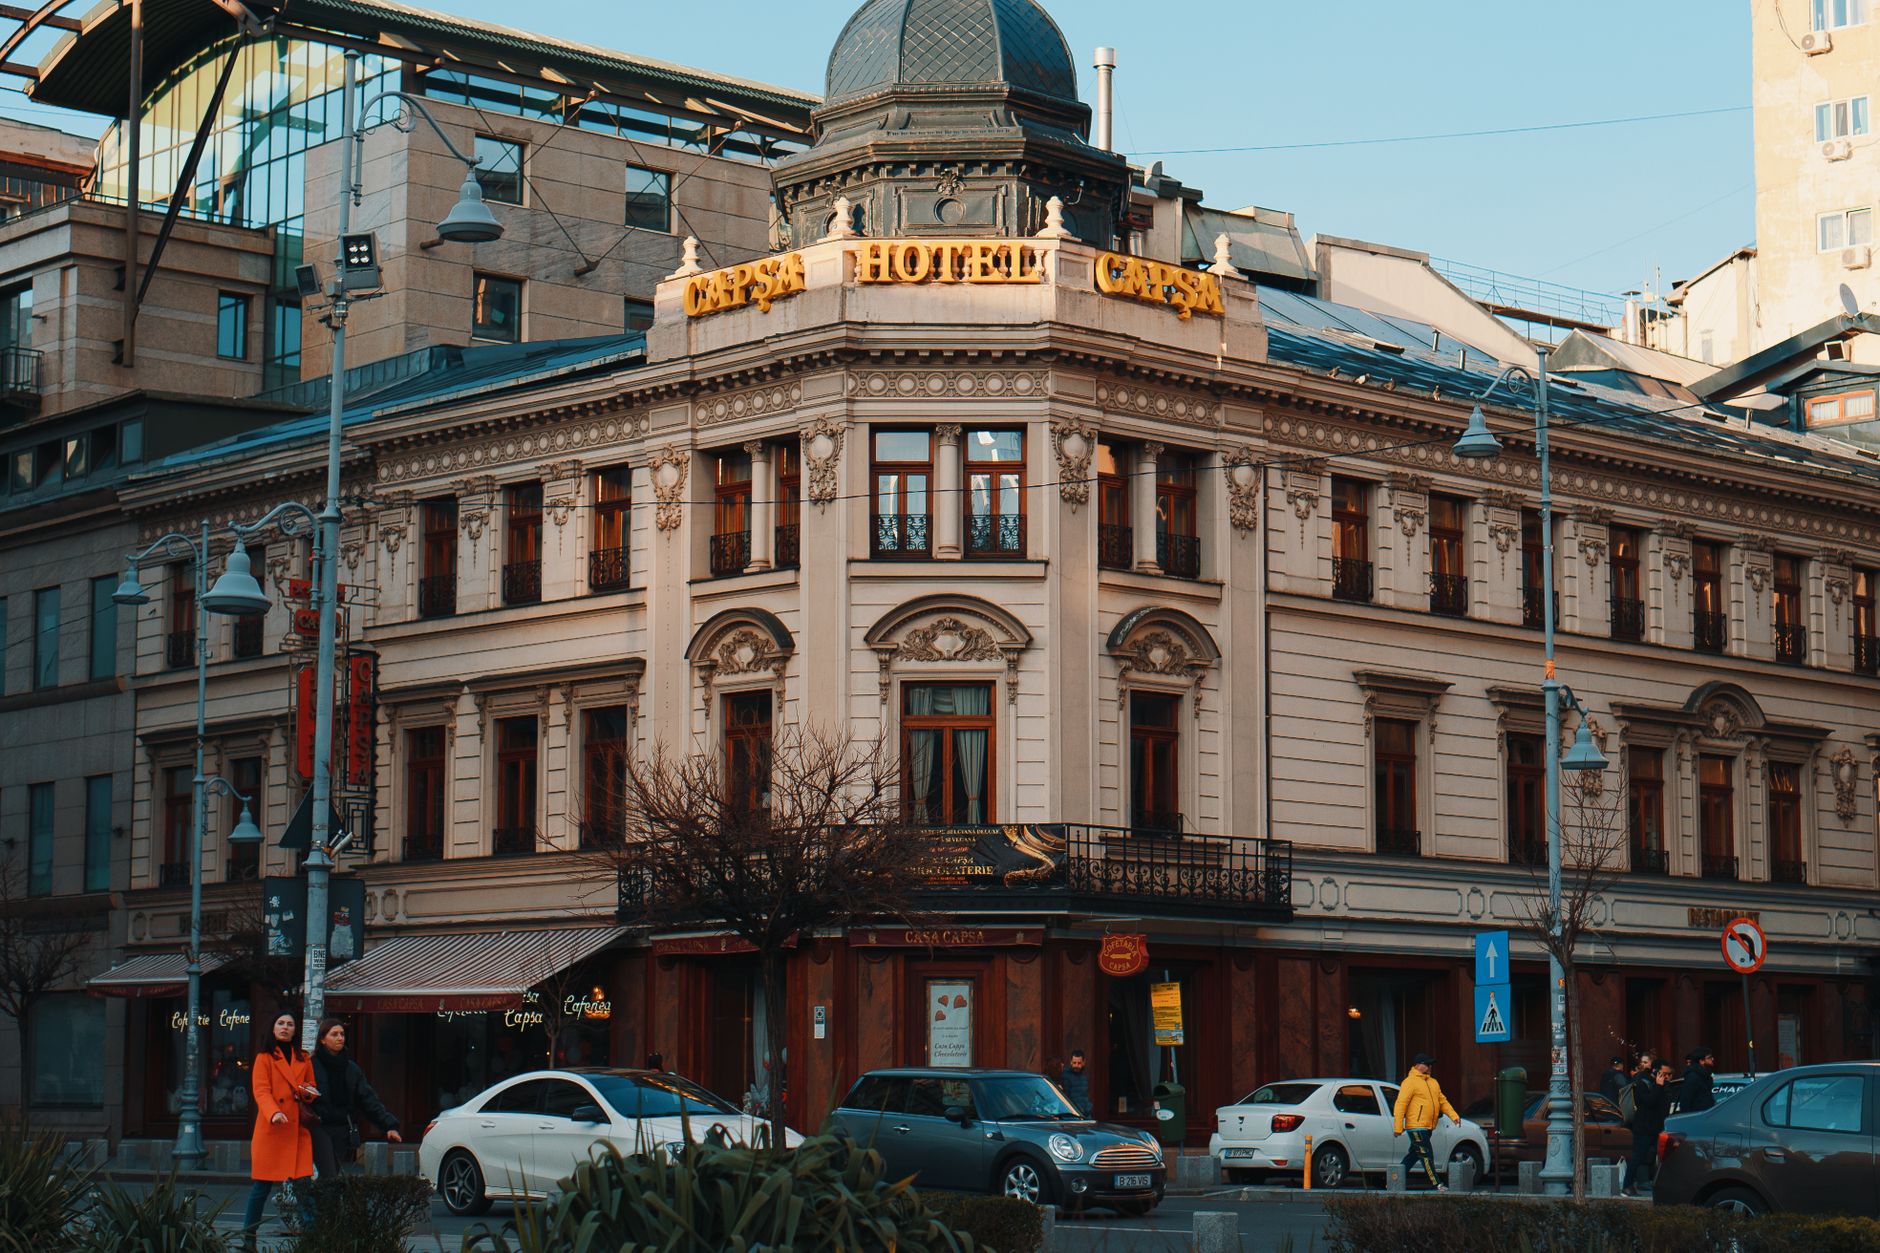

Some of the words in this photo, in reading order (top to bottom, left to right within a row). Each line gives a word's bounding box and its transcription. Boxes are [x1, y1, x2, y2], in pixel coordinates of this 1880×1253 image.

[858, 240, 1041, 284] HOTEL
[905, 930, 940, 944] CASA
[563, 994, 612, 1020] Cafenea
